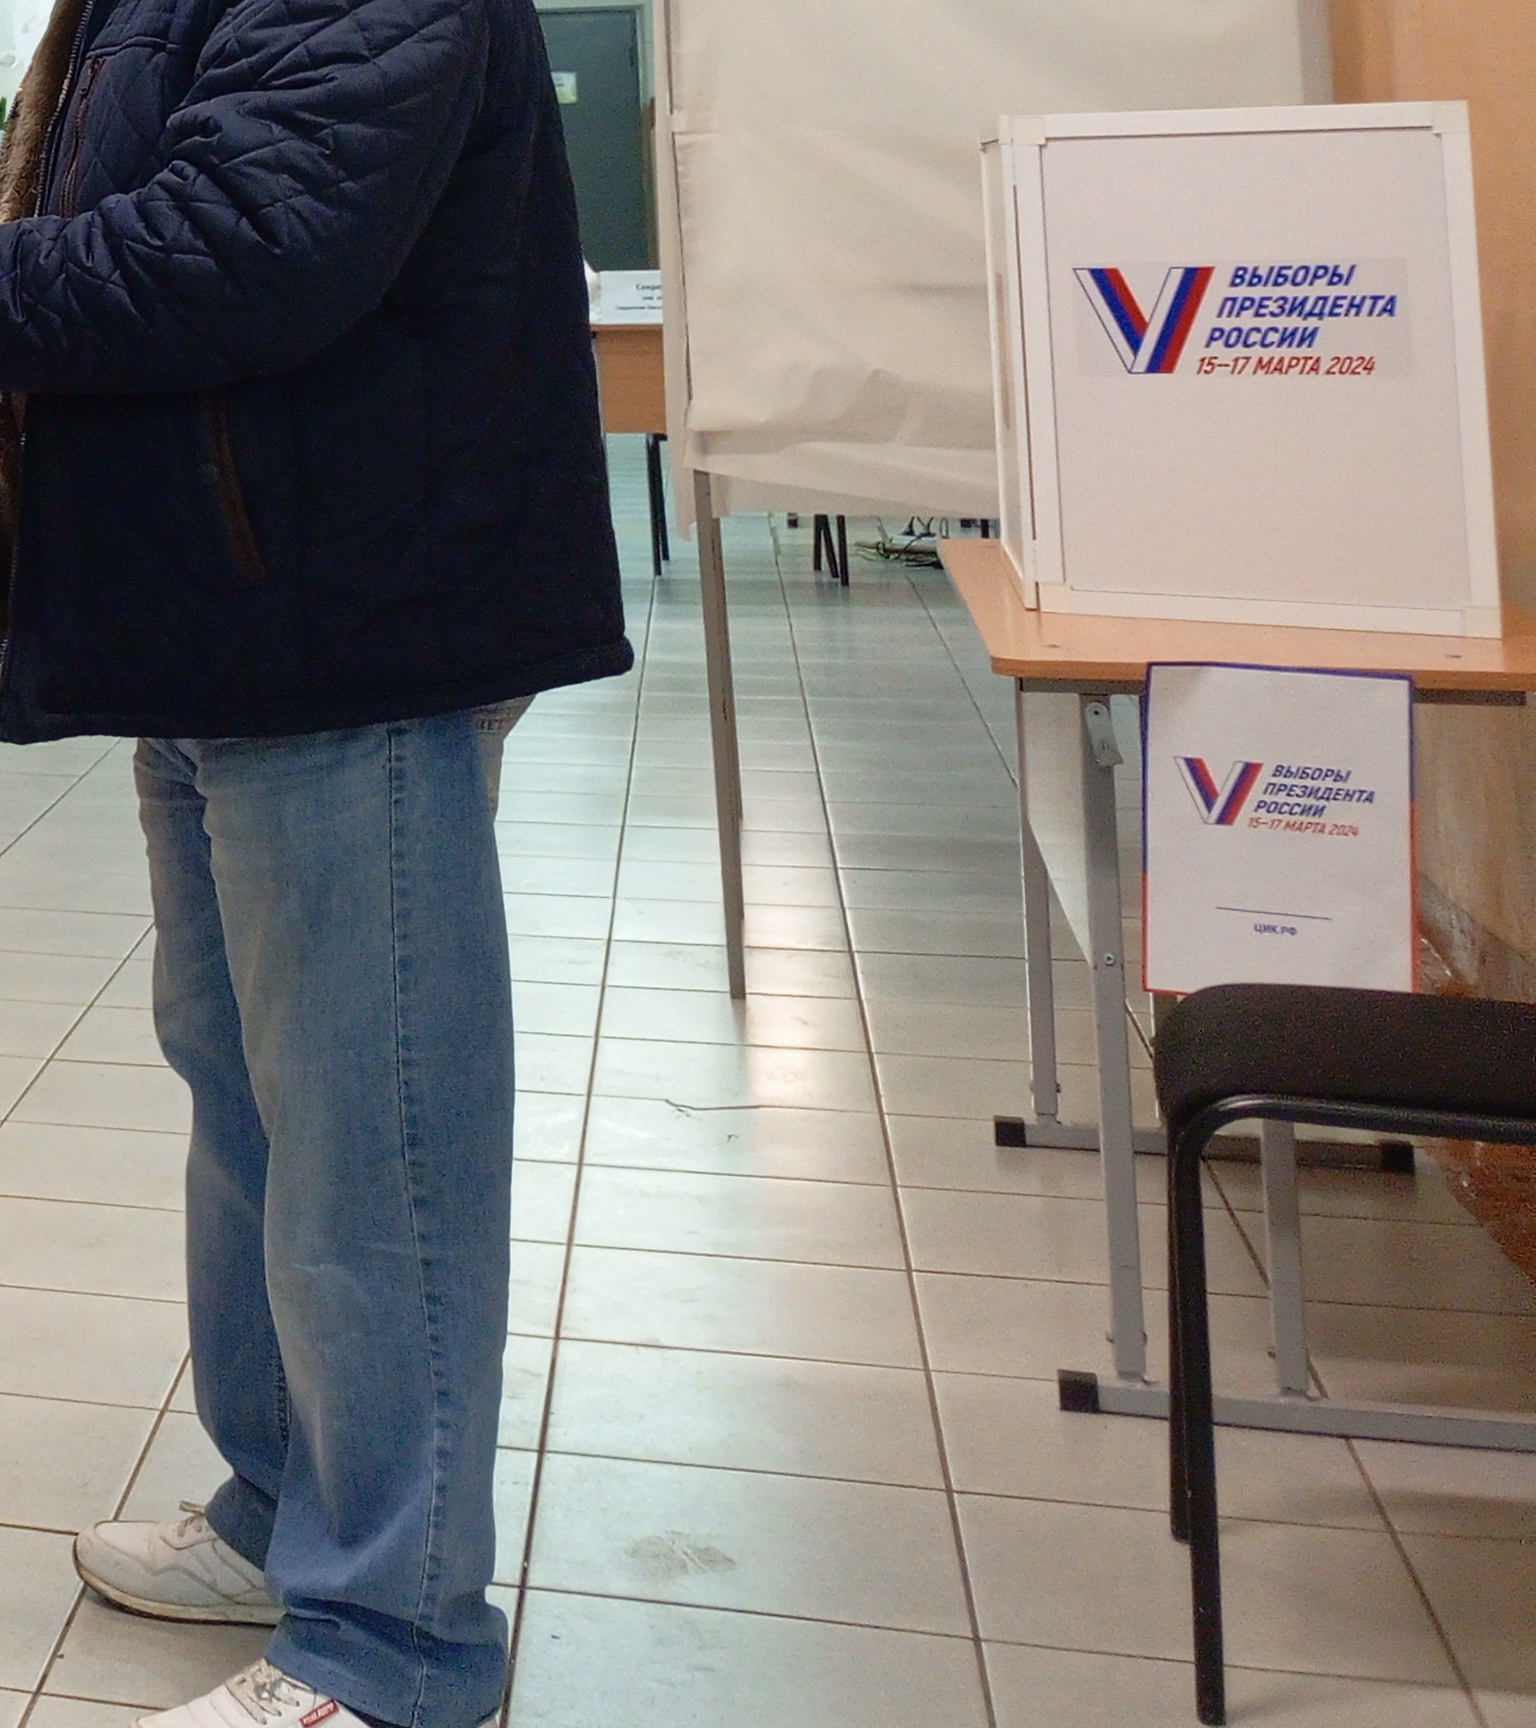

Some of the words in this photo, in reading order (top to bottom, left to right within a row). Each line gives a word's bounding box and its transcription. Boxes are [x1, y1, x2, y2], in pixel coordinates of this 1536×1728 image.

[1229, 264, 1357, 287] ВЫБОРЫ
[1216, 295, 1397, 321] ПРЕЗИДЕНТА
[1204, 326, 1320, 349] РОССИИ
[1252, 356, 1322, 375] МАРТА
[1325, 356, 1376, 375] 2024
[1271, 763, 1352, 783] ВЫБОРЫ
[1263, 782, 1375, 804] ПРЕЗИДЕНТА
[1254, 799, 1327, 818] РОССИИ
[1284, 818, 1327, 835] МАРТА
[1327, 823, 1359, 837] 2024
[1254, 923, 1297, 936] ЦИК.РФ
